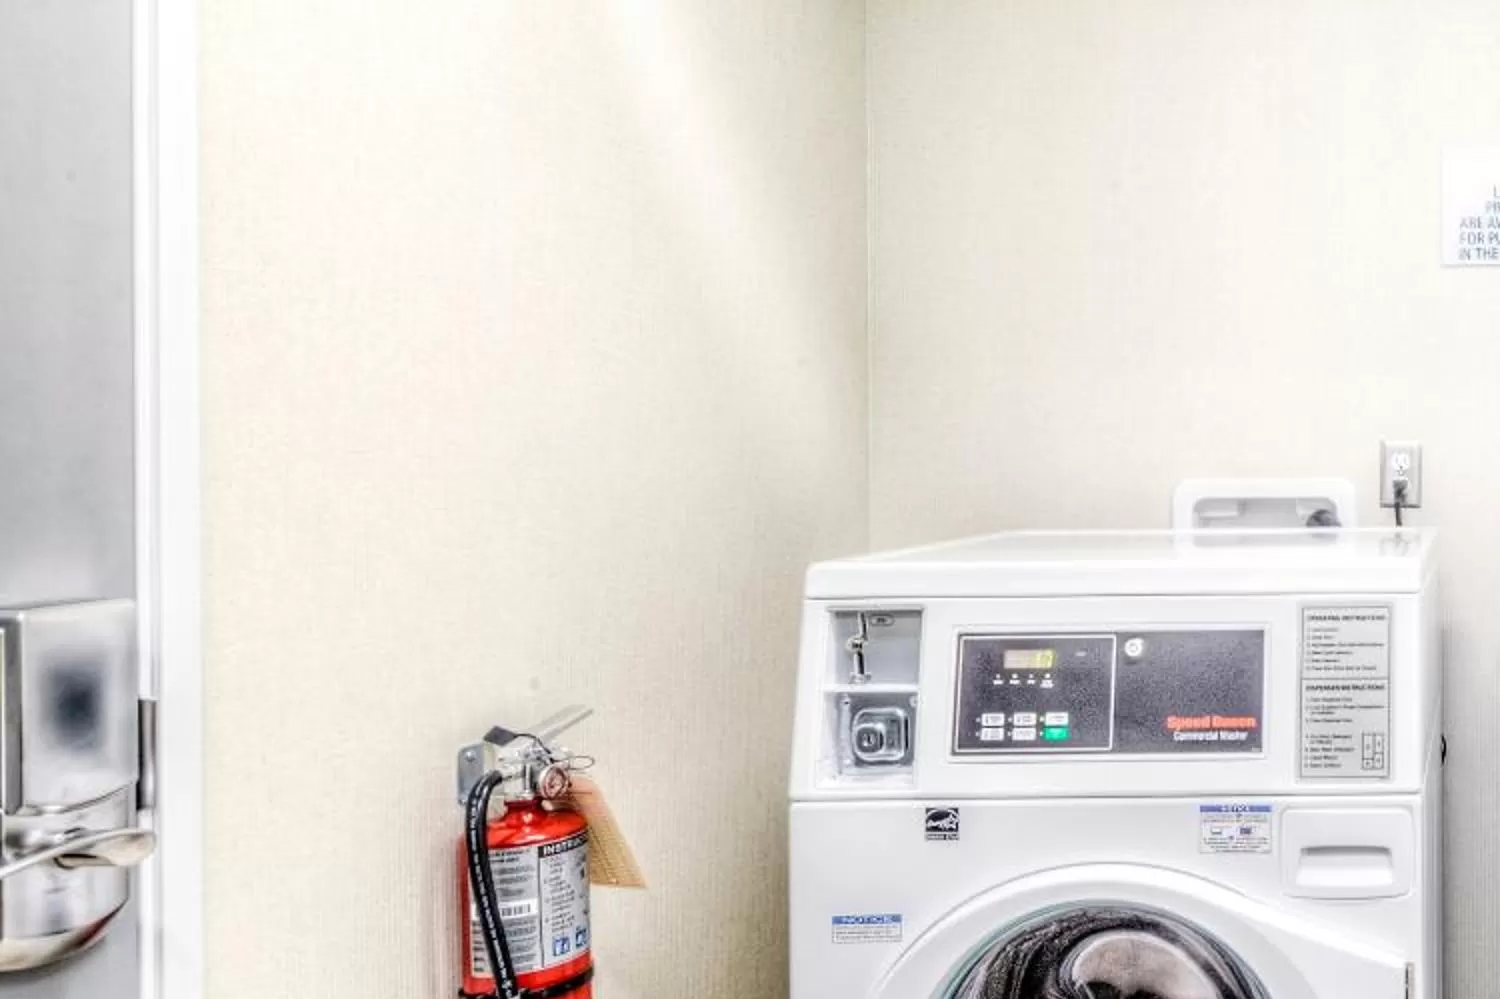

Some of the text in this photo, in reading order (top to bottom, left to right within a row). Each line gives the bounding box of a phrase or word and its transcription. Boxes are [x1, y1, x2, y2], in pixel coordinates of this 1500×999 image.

[1460, 216, 1483, 229] ARE
[1459, 231, 1484, 245] FOR
[1458, 247, 1471, 260] IN
[1475, 247, 1499, 260] THE
[1167, 715, 1257, 731] Speed Queen
